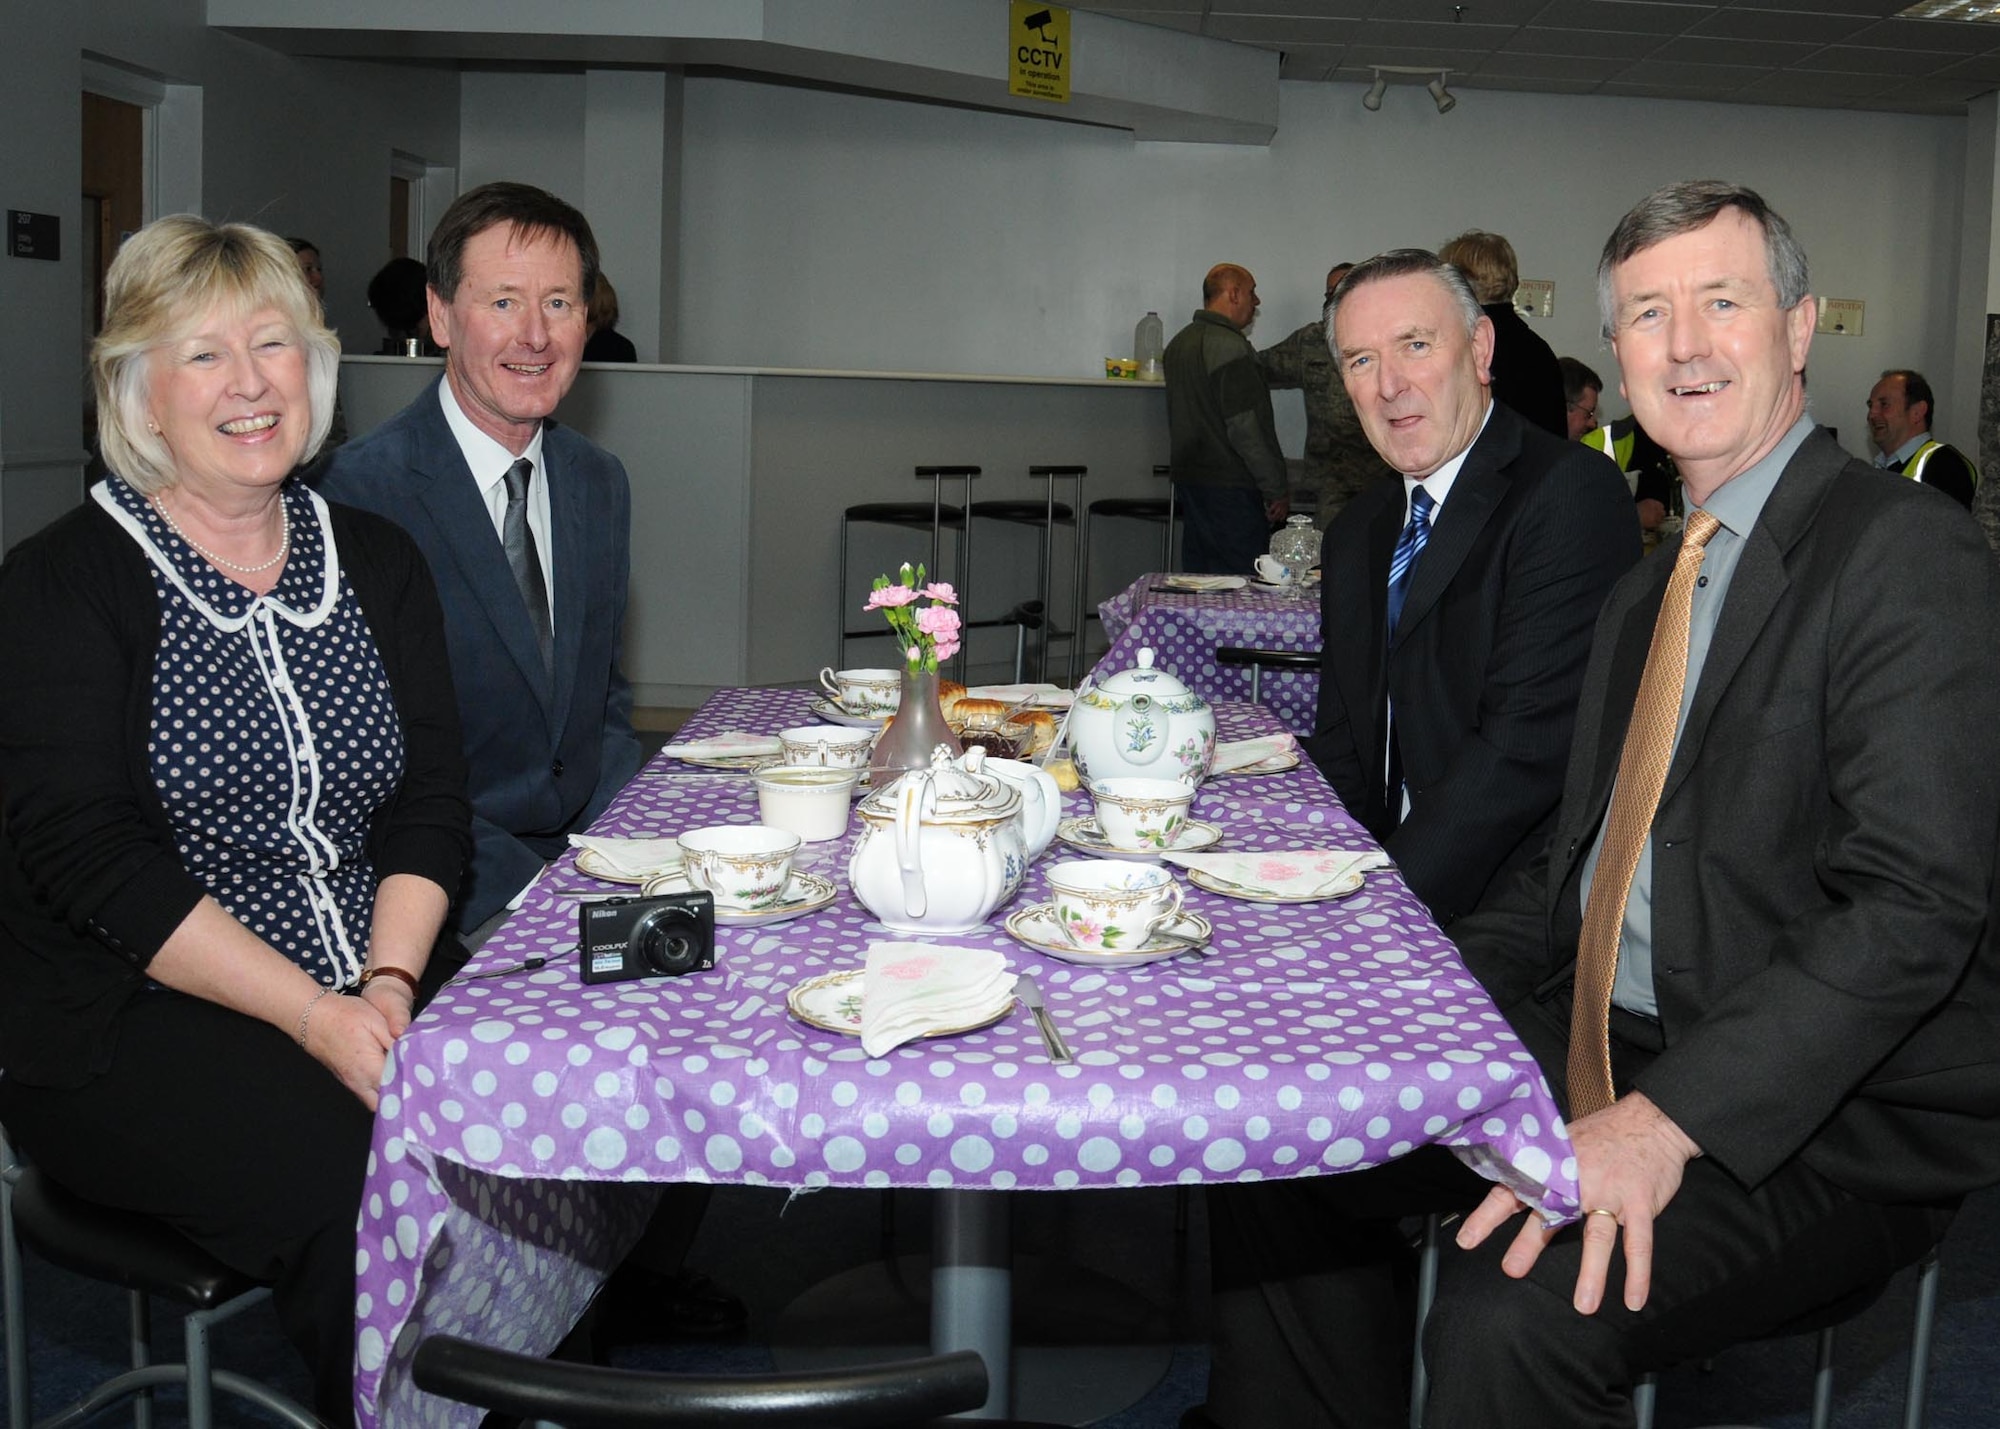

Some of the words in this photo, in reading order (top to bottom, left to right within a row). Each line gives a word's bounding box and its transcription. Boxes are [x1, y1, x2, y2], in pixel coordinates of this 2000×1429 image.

[1017, 46, 1062, 69] CCTV
[1019, 67, 1027, 75] in
[1027, 70, 1060, 80] operation
[17, 212, 32, 224] 207
[592, 909, 617, 919] Nikon
[592, 941, 629, 951] COOLPIX
